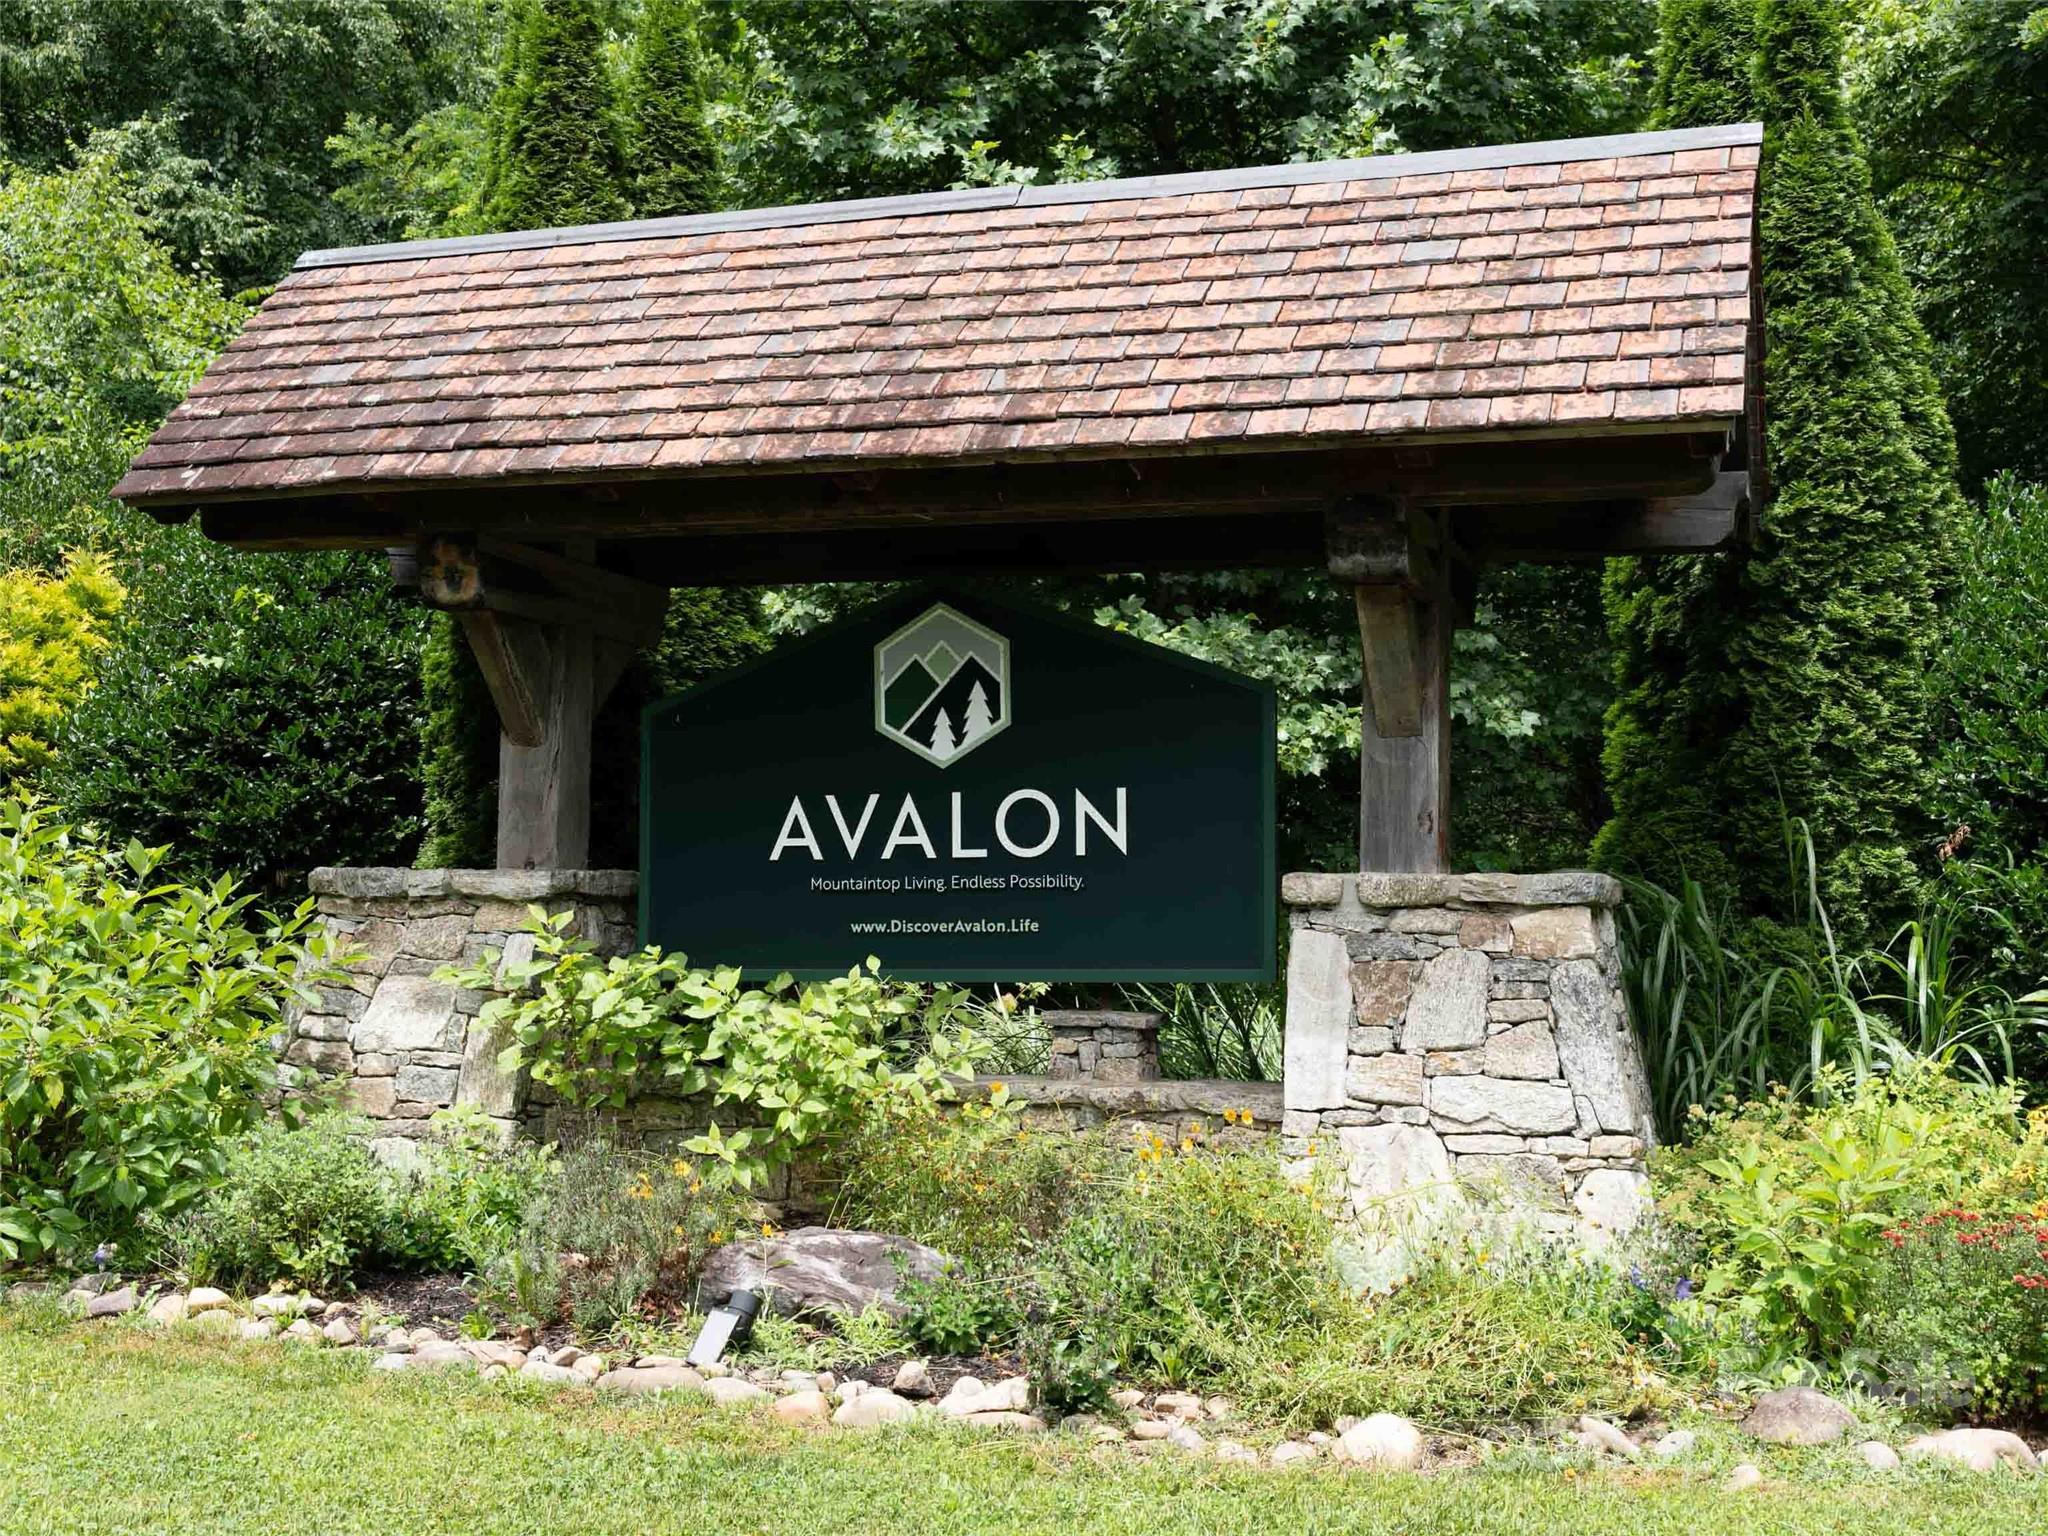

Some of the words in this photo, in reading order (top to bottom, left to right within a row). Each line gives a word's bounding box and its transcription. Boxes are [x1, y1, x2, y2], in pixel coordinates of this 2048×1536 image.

[769, 787, 1128, 861] AVALON
[810, 876, 901, 893] Mountaintop
[904, 875, 948, 893] Living.
[951, 874, 1006, 890] Endless
[1010, 873, 1085, 892] Possibility.
[850, 918, 1040, 933] www.DiscoverAvalon.Life
